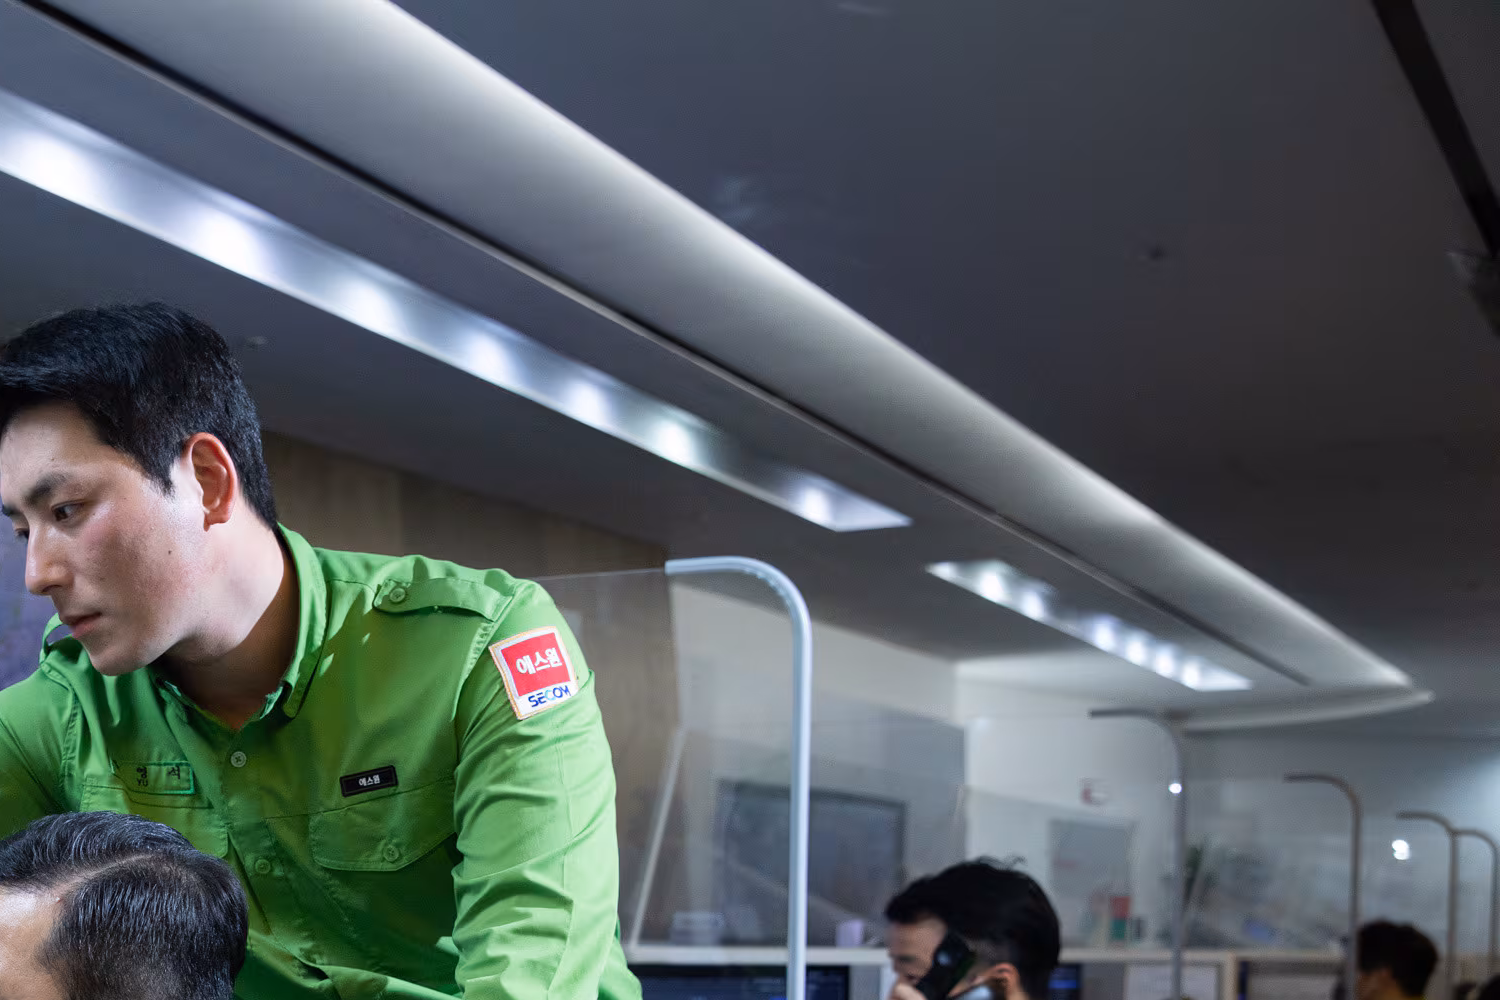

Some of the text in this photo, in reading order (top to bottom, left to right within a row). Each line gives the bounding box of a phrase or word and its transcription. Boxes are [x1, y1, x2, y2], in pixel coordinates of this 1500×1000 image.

[515, 647, 563, 675] 에스원
[528, 685, 571, 707] SECOM
[358, 774, 381, 786] 에스원
